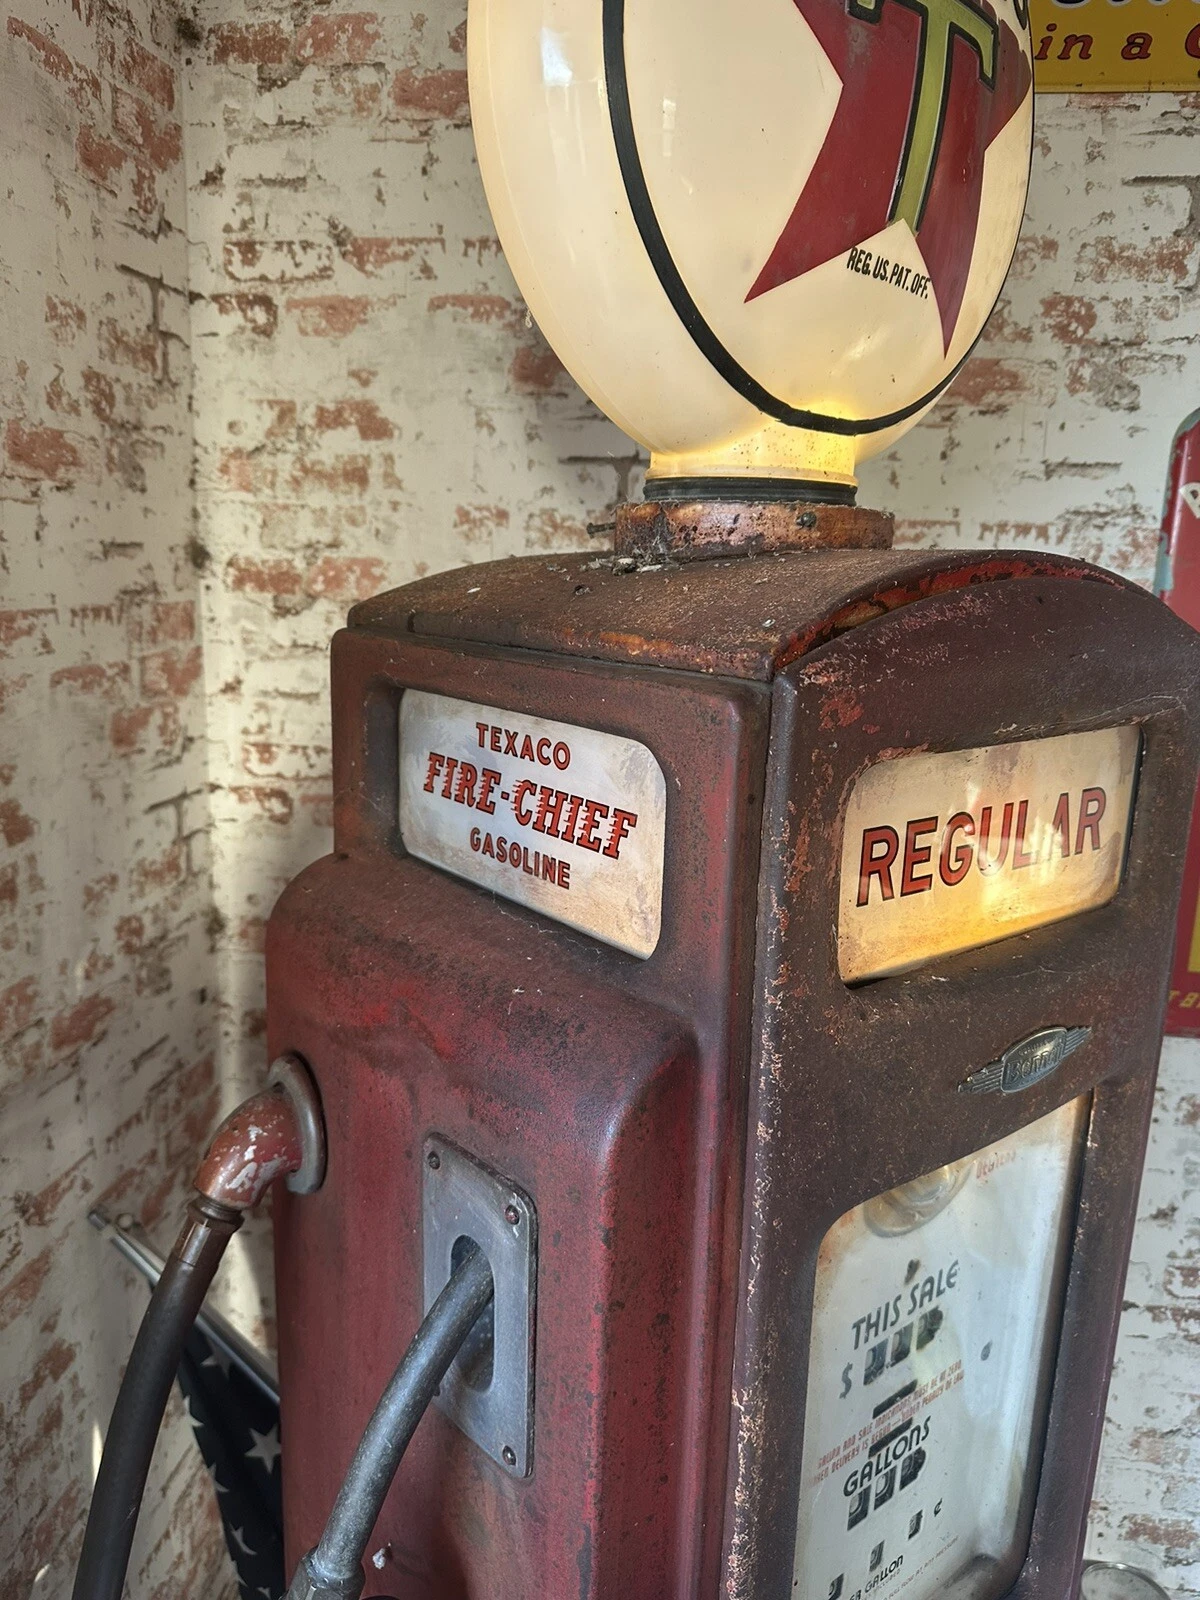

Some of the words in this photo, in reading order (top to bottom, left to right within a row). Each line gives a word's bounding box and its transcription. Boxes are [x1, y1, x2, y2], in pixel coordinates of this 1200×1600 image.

[1034, 23, 1094, 60] in
[1121, 32, 1153, 60] a
[889, 263, 912, 291] PAT.
[910, 273, 931, 299] OFF.
[476, 722, 571, 770] TEXACO
[423, 752, 638, 860] FIRE-CHIEF
[470, 827, 571, 889] GASOLINE
[856, 786, 1107, 908] REGULAR
[852, 1294, 902, 1350] THIS
[907, 1259, 959, 1315] SALE
[843, 1415, 931, 1497] GALLONS
[865, 1554, 904, 1593] GALLON
